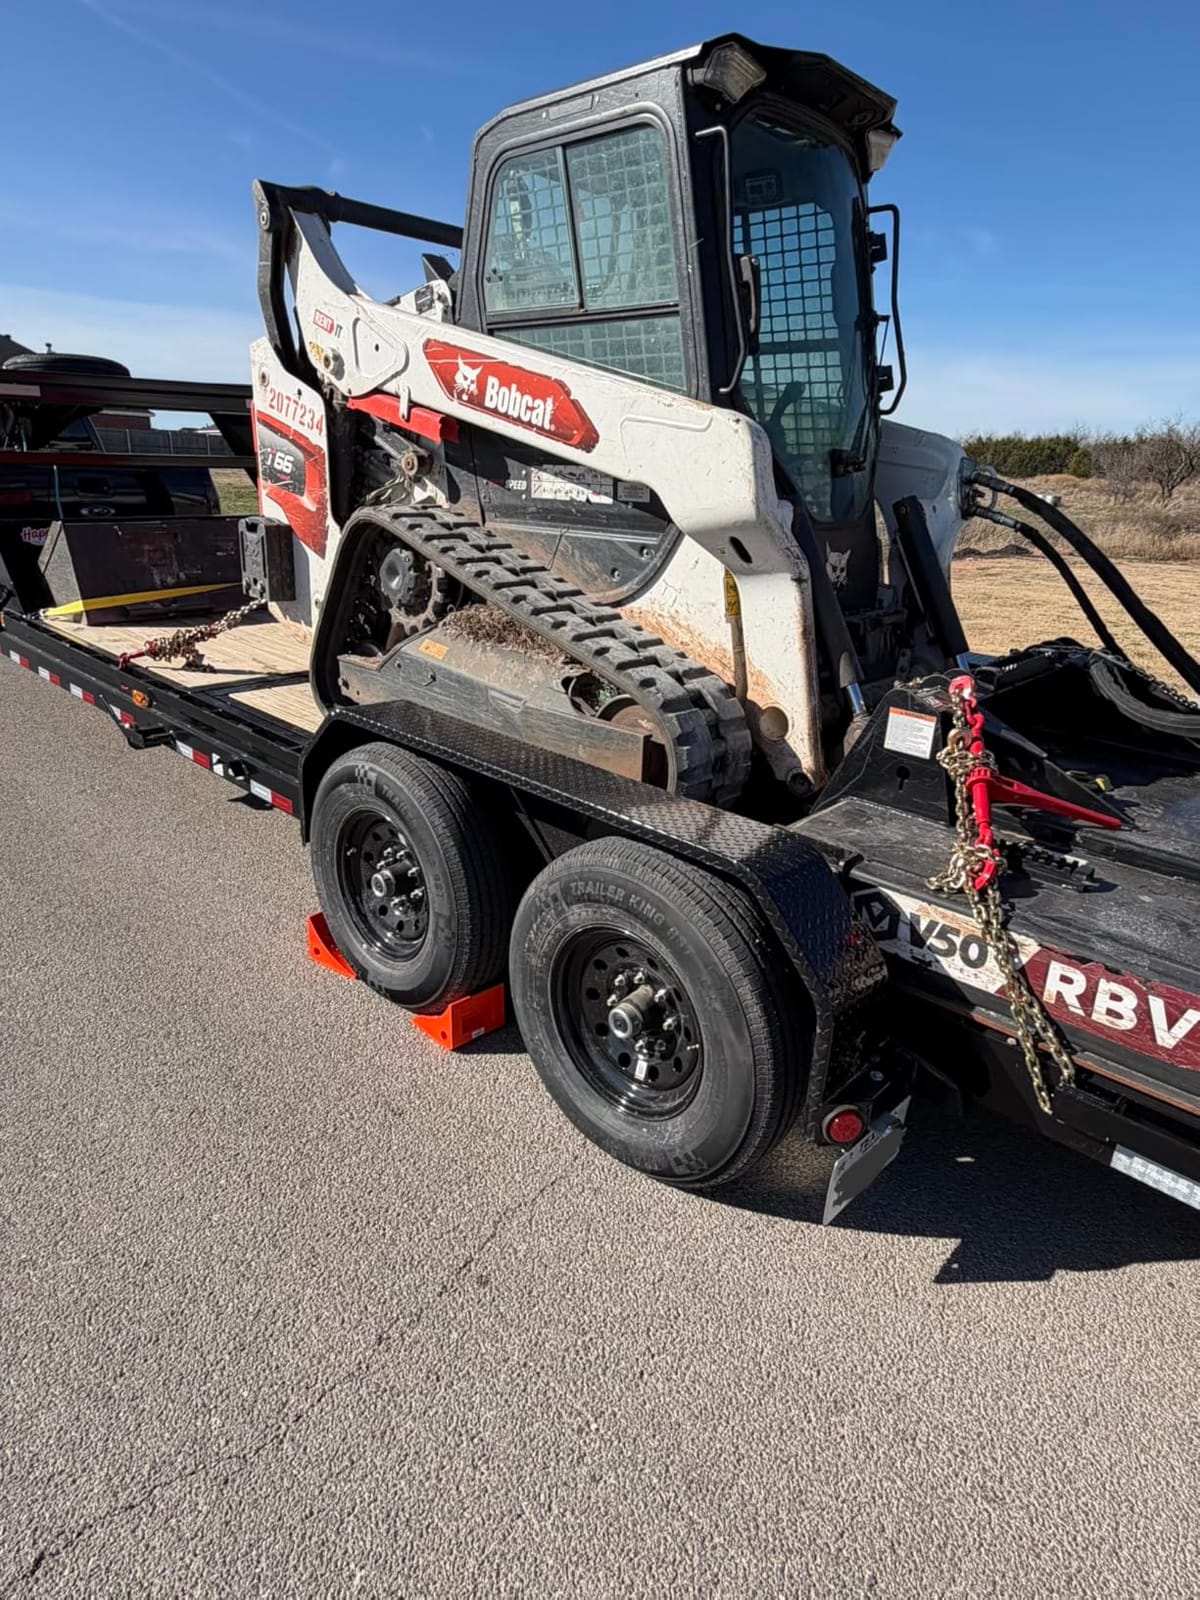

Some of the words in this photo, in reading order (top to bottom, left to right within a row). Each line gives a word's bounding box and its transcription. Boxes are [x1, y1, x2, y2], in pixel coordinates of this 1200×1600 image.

[334, 324, 343, 338] IT
[268, 387, 324, 437] 2077234
[484, 375, 555, 431] Bobcat
[569, 881, 625, 901] TRAILER
[629, 894, 665, 926] KING
[909, 912, 989, 969] V50
